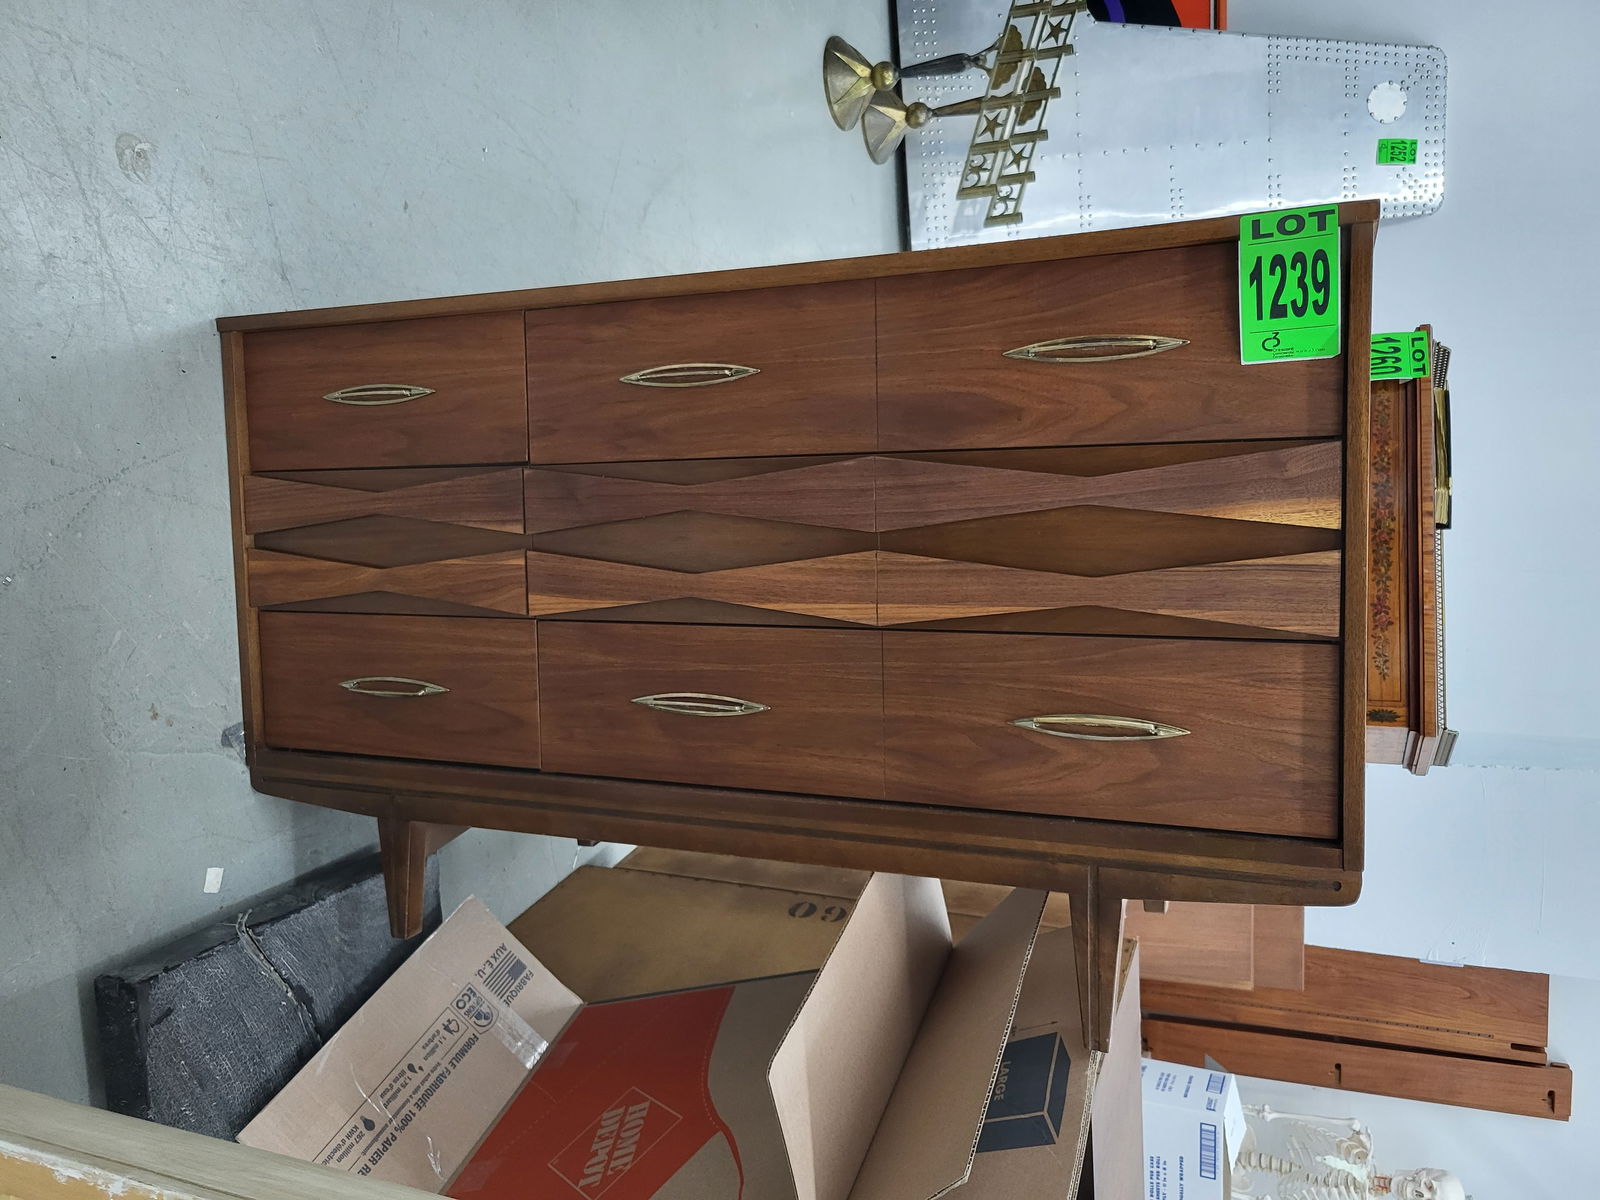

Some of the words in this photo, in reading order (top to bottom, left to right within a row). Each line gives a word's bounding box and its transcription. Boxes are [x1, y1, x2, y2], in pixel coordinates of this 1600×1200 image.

[1390, 140, 1408, 162] 1252
[1251, 209, 1336, 240] LOT
[1249, 248, 1331, 321] 1239
[1371, 335, 1402, 378] 1260
[1410, 336, 1427, 376] LOT
[488, 942, 508, 963] AUX
[447, 1032, 479, 1069] FORMULE
[412, 1065, 453, 1112] FABRIQUÉE
[993, 1060, 1013, 1101] LARGE
[393, 1108, 417, 1134] 100%
[607, 1100, 651, 1176] HOME
[335, 1141, 356, 1164] million
[367, 1131, 398, 1165] PAPIER
[577, 1105, 625, 1188] DEPOT
